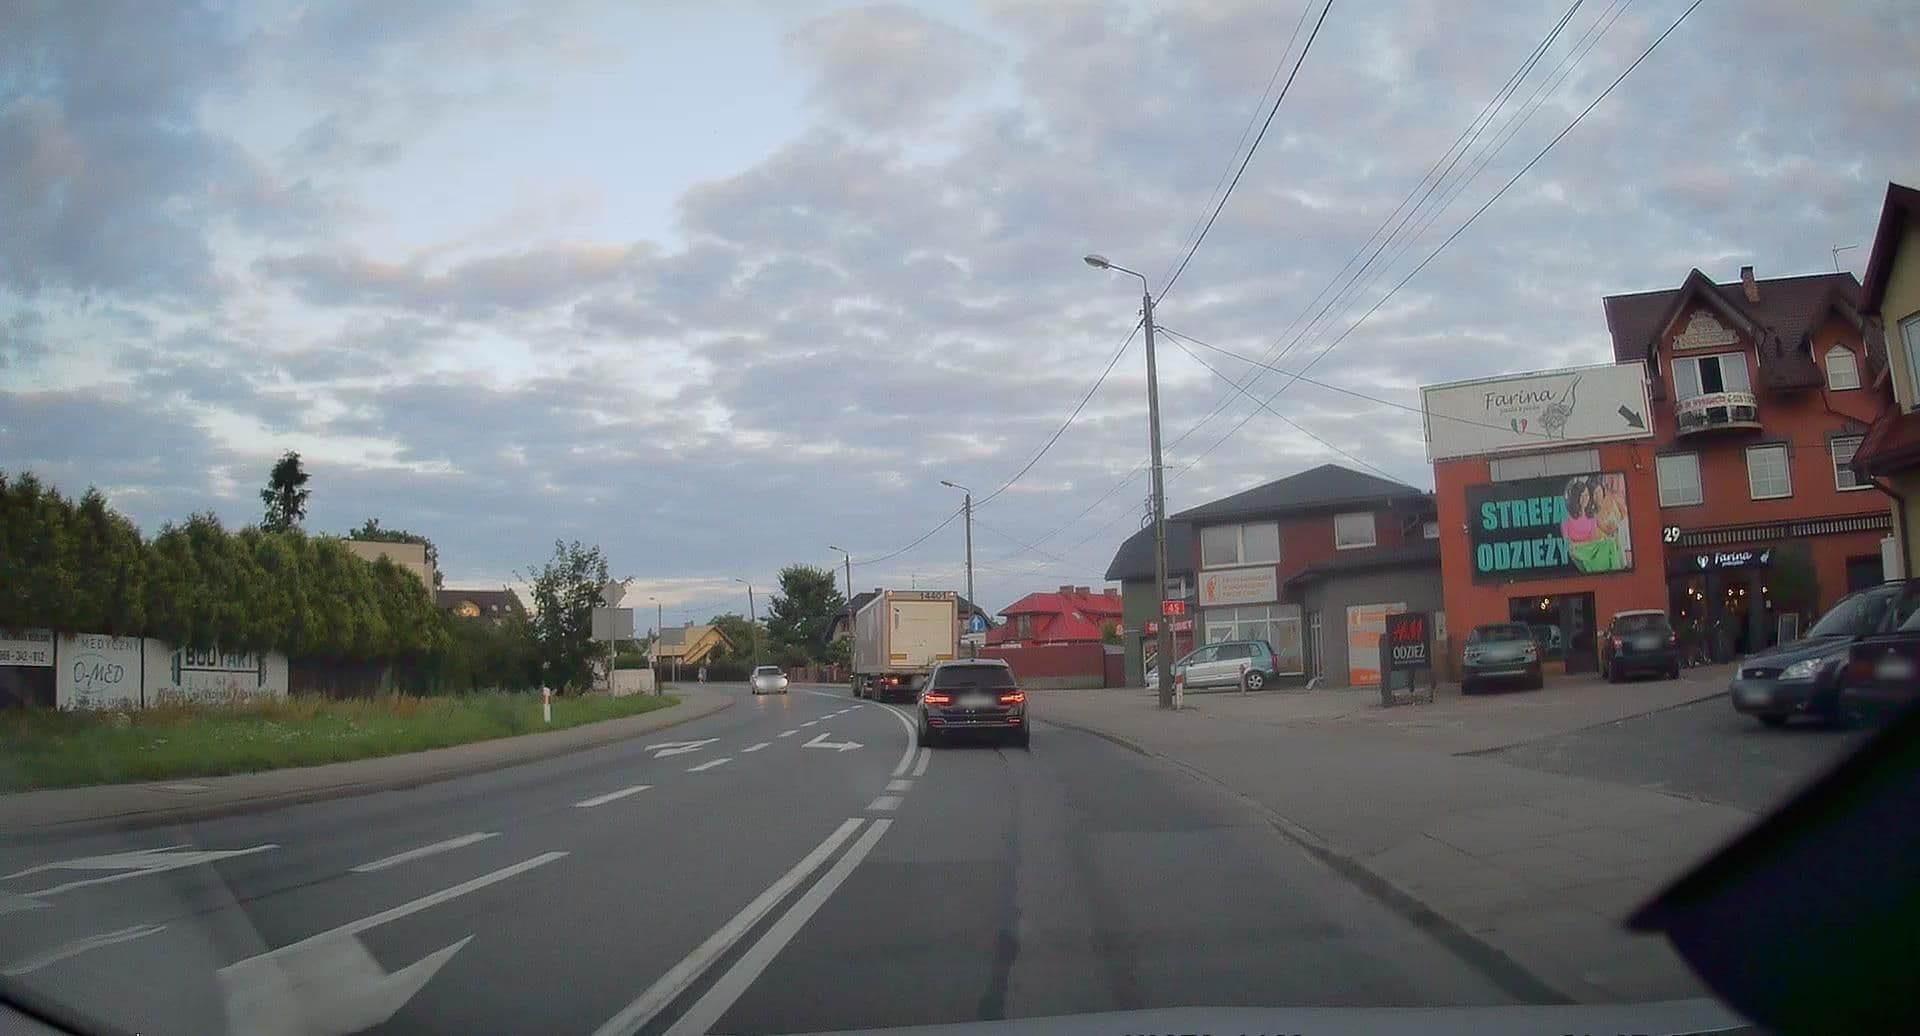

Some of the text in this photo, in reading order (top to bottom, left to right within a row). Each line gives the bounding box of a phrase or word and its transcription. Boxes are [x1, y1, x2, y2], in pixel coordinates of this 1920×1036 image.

[1485, 390, 1557, 410] Farina
[1481, 496, 1568, 530] STREFA
[1663, 527, 1680, 542] 29
[1477, 533, 1569, 571] ODZIEŻY
[1714, 551, 1753, 564] Farina
[73, 662, 124, 686] O-MED
